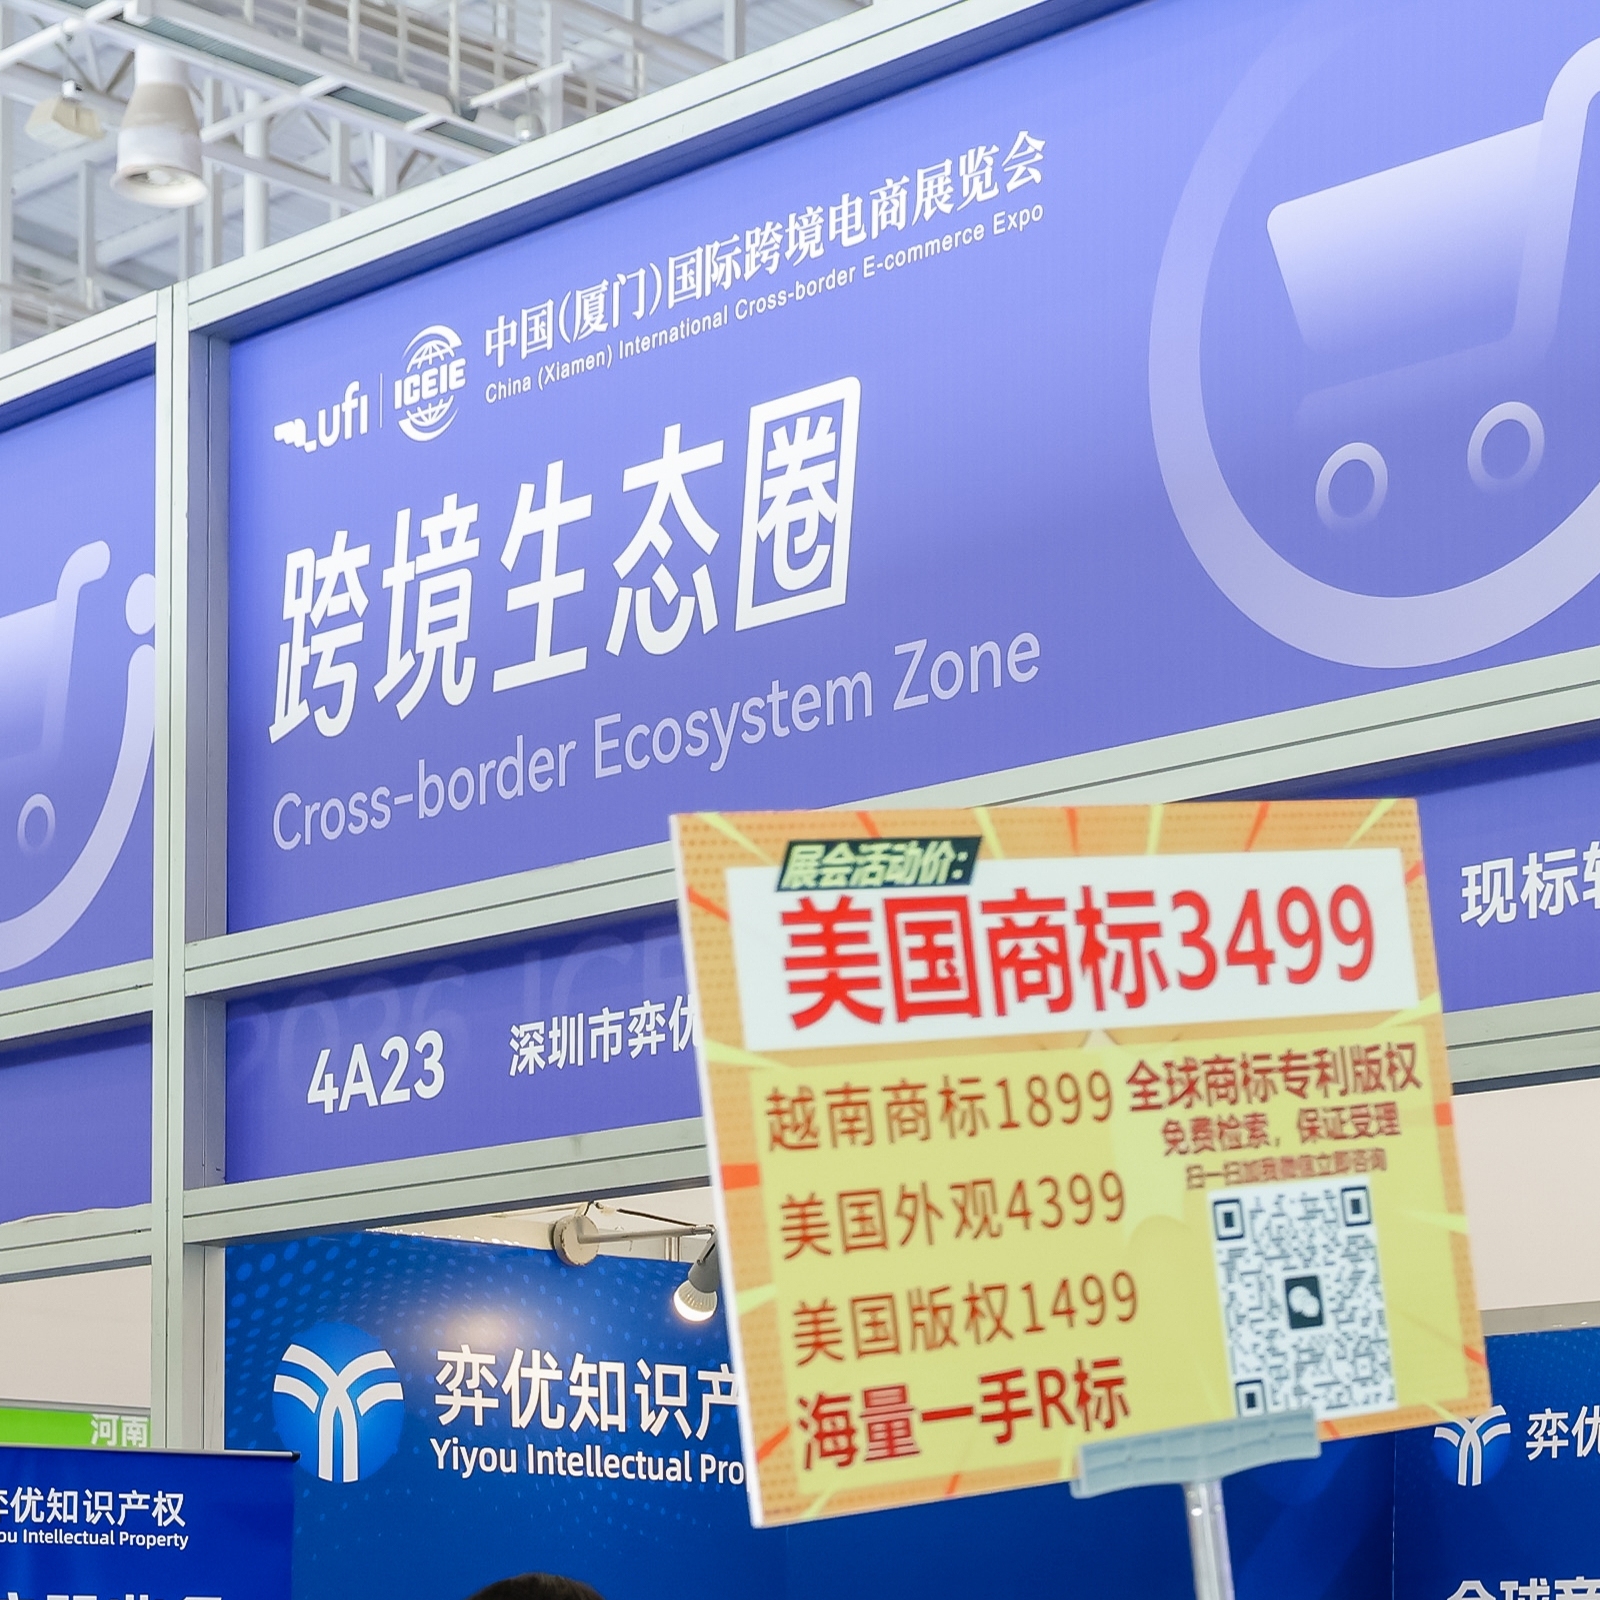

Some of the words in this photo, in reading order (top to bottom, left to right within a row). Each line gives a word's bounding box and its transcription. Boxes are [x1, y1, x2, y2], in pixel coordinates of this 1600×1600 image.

[485, 130, 1046, 370] 中国(厦门)国际跨境电商展览会
[485, 375, 532, 405] China
[538, 349, 613, 391] (Xiamen)
[619, 311, 728, 361] International
[735, 267, 855, 320] Cross-border
[863, 225, 984, 278] E-commerce
[992, 204, 1044, 239] Expo
[317, 381, 368, 449] ufi
[395, 361, 466, 408] ICEIE
[269, 376, 861, 744] 跨境生态圈
[273, 735, 577, 852] Cross-border
[594, 666, 873, 779] Ecosystem
[894, 629, 1041, 711] Zone
[781, 885, 1376, 1029] 美国商标3499
[308, 1030, 445, 1114] 4A23
[509, 995, 700, 1077] 深圳市弈优
[1126, 1042, 1422, 1112] 全球商标专利版权
[767, 1070, 1115, 1154] 越南商标1899
[779, 1170, 1127, 1262] 美国外观4399
[793, 1270, 1139, 1367] 美国版权1499
[91, 1413, 149, 1448] 河南
[434, 1344, 741, 1441] 弈优知识产
[797, 1358, 1130, 1472] 海量一手R标
[430, 1438, 518, 1479] Yiyou
[527, 1442, 691, 1483] Intellectual
[23, 1528, 115, 1546] Intellectual
[120, 1531, 189, 1551] Property
